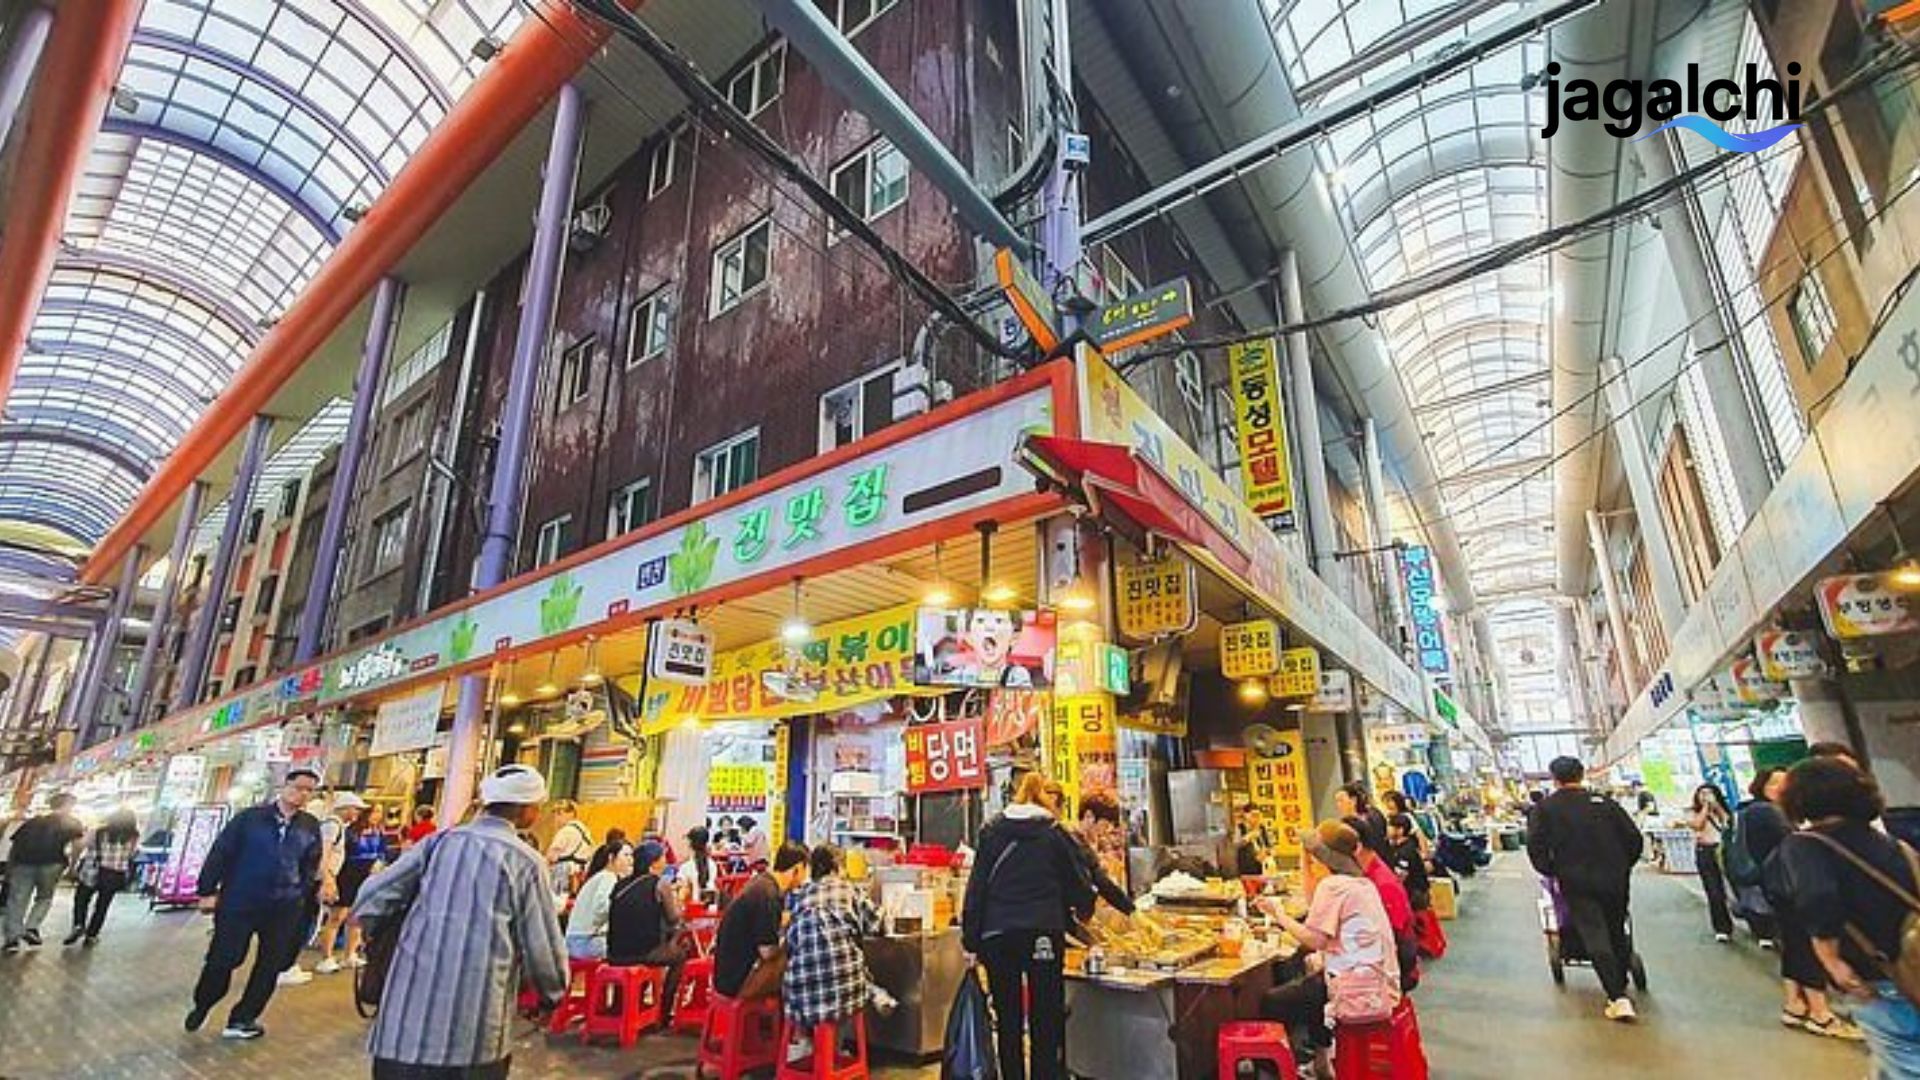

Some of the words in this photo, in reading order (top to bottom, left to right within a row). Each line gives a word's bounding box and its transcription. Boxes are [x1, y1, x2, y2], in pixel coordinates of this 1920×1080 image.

[1127, 574, 1180, 600] 진맛집
[1225, 631, 1269, 652] 진맛집
[1284, 657, 1312, 673] 맛집
[926, 727, 979, 781] 당면
